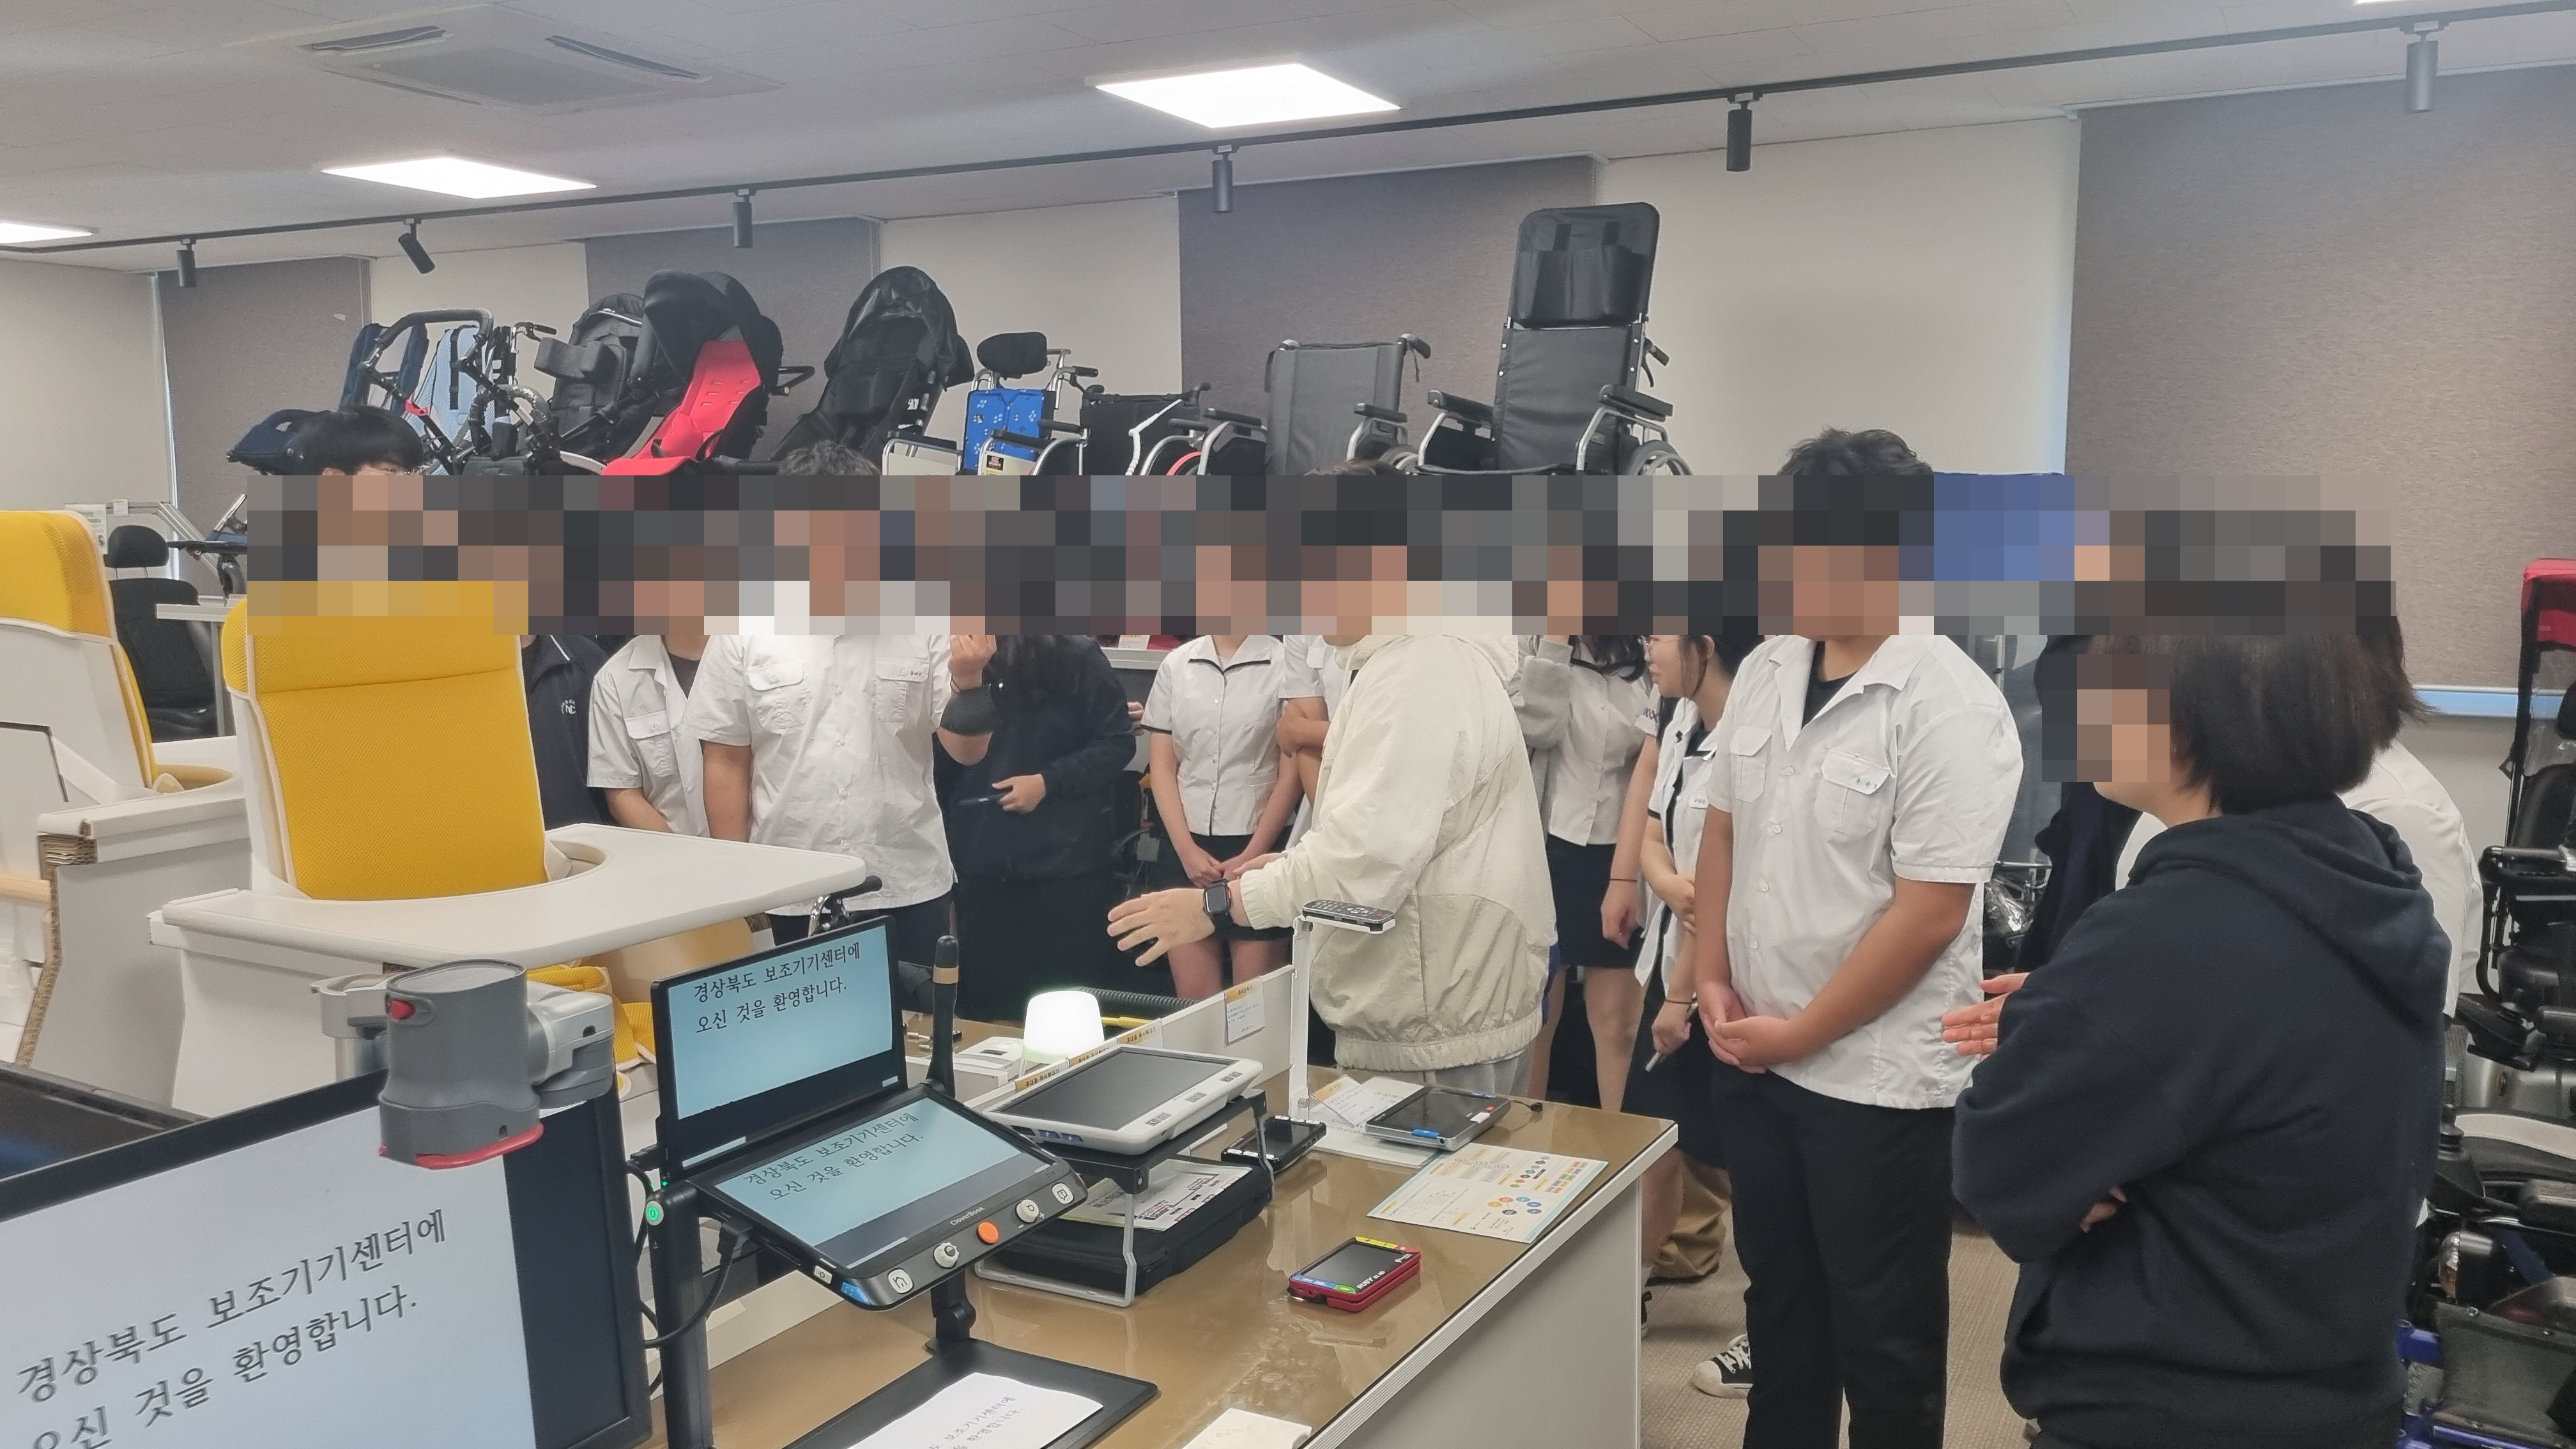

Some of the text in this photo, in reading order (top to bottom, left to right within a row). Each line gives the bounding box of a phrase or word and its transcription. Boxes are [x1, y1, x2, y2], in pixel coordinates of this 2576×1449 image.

[694, 942, 861, 1003] 경상북도 보조기기센터에
[696, 976, 847, 1033] 오신 것을 환영합니다.
[744, 1112, 919, 1184] 경상북도 보조기기센터에
[770, 1133, 924, 1200] 오신 것을 환영합니다.
[949, 1206, 985, 1226] CloverBook
[17, 1208, 447, 1404] 경상북도 보조기기센터에
[1356, 1276, 1374, 1290] RUBY
[135, 1367, 215, 1429] 것을
[232, 1284, 417, 1384] 환영합니다.
[943, 1396, 1016, 1442] 보조기기센터에
